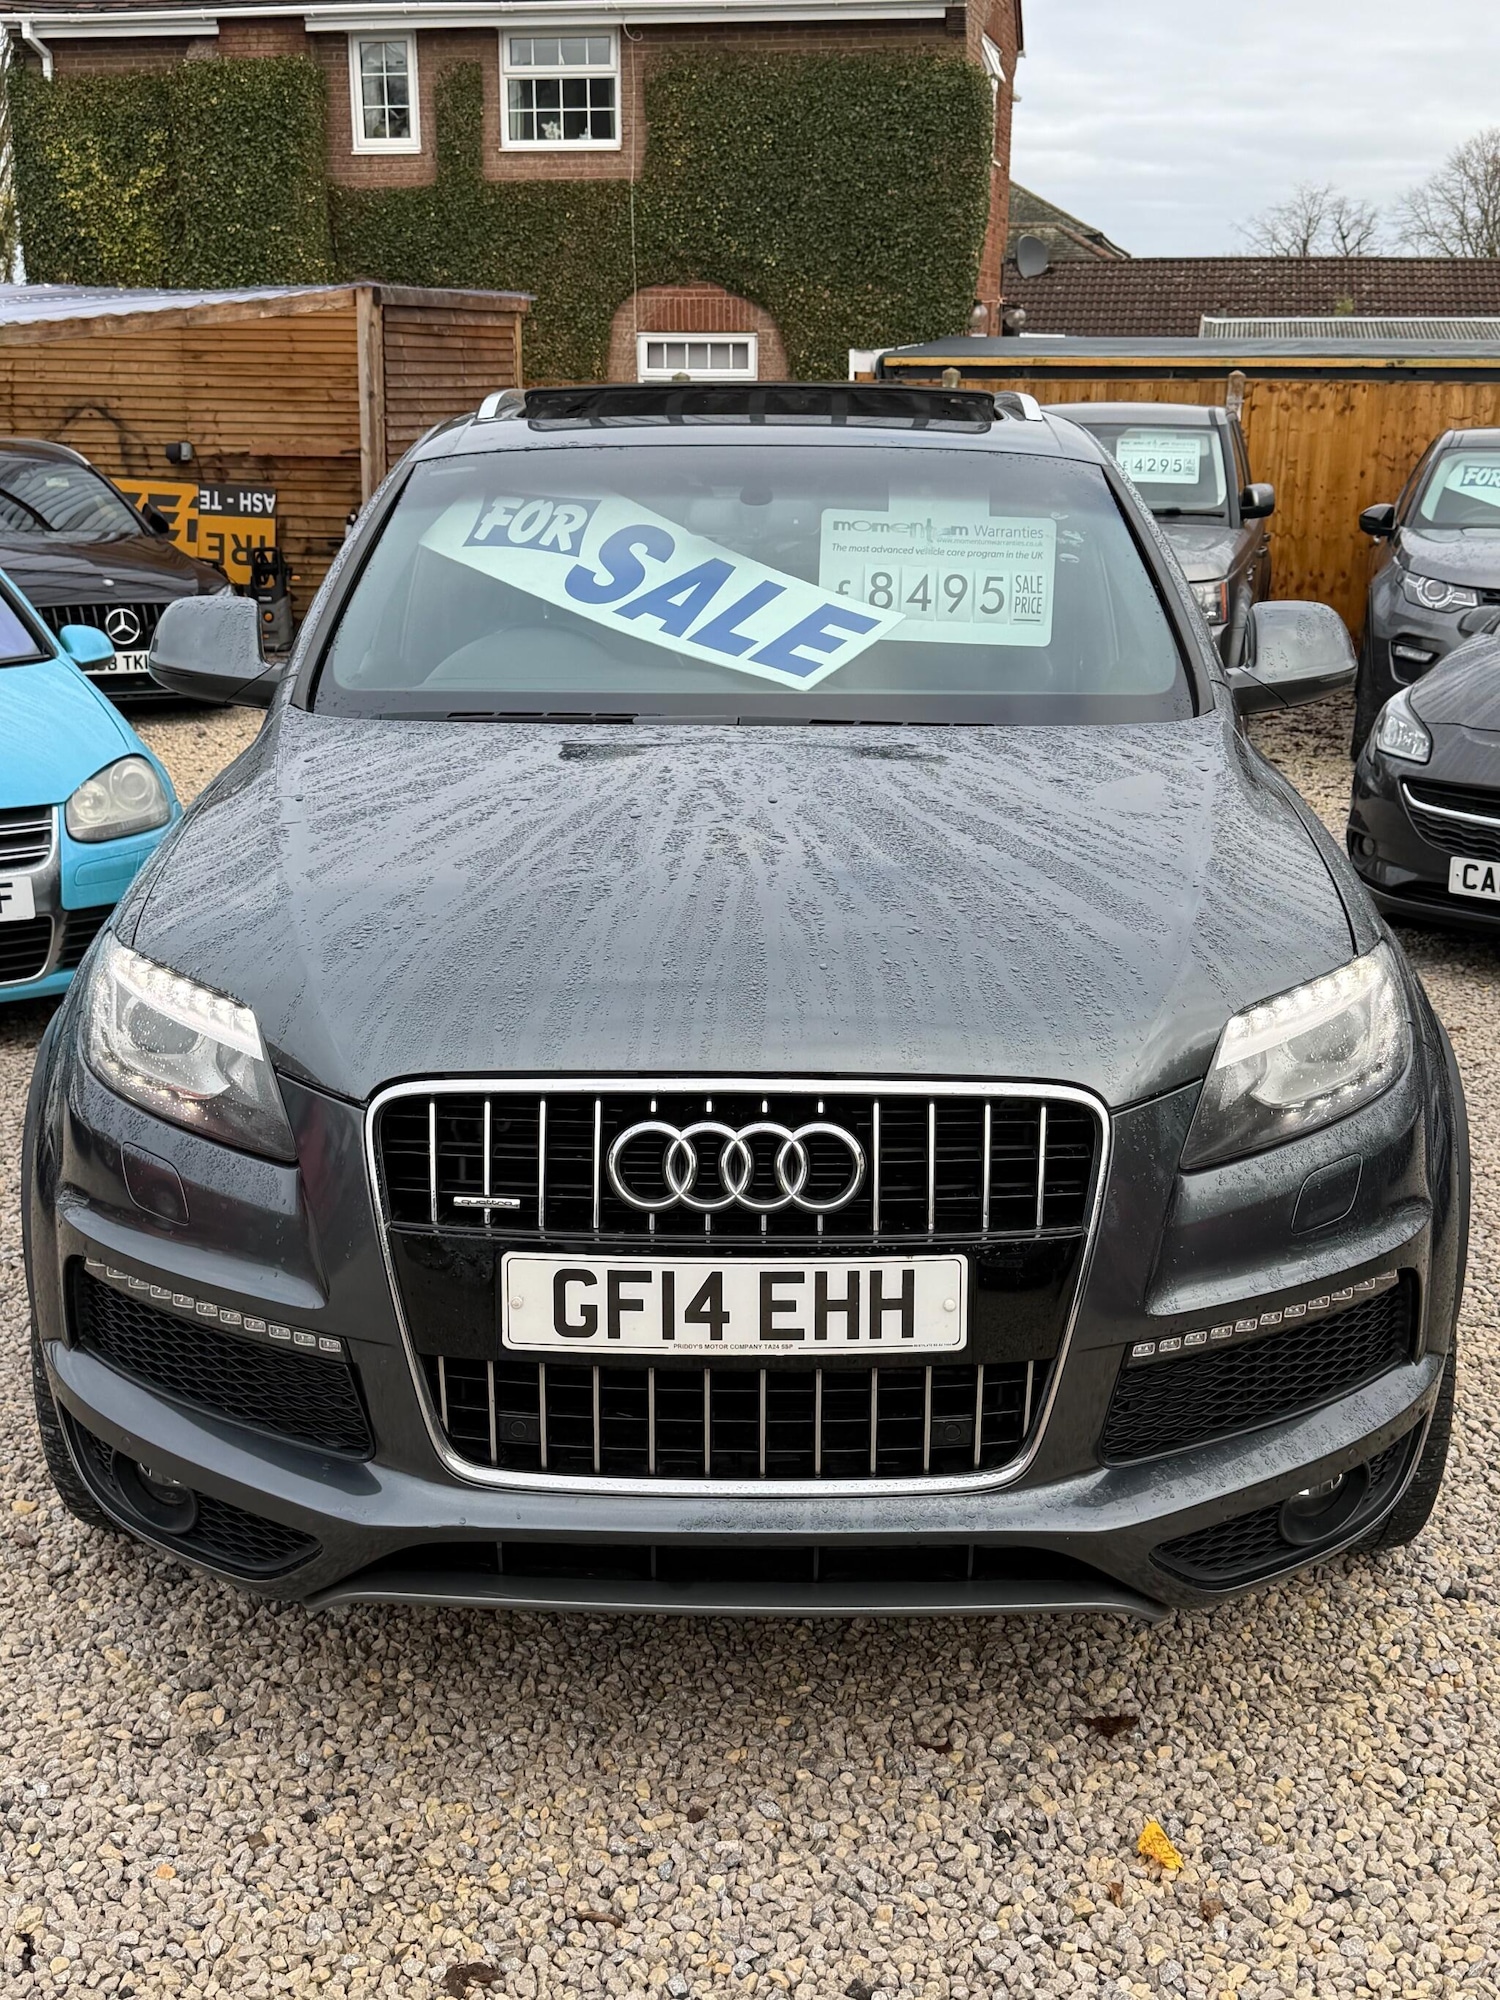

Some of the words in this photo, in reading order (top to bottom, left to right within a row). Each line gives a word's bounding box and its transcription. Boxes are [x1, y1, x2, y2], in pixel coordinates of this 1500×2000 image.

[1462, 467, 1500, 487] FOR
[200, 490, 222, 510] TE
[239, 492, 276, 513] ASH
[474, 496, 588, 552] FOR
[833, 518, 969, 543] momentm
[974, 525, 1044, 539] Warranties
[832, 543, 848, 552] The
[848, 545, 870, 553] most
[870, 546, 914, 555] advanced
[915, 547, 945, 556] vehicle
[946, 549, 966, 557] care
[967, 550, 1005, 560] program
[1006, 550, 1014, 559] in
[1015, 551, 1030, 560] the
[1031, 552, 1044, 560] UK
[1015, 575, 1043, 594] SALE
[564, 524, 882, 678] SALE
[1014, 597, 1042, 614] PRICE
[553, 1268, 730, 1341] GF14
[759, 1269, 915, 1341] EHH
